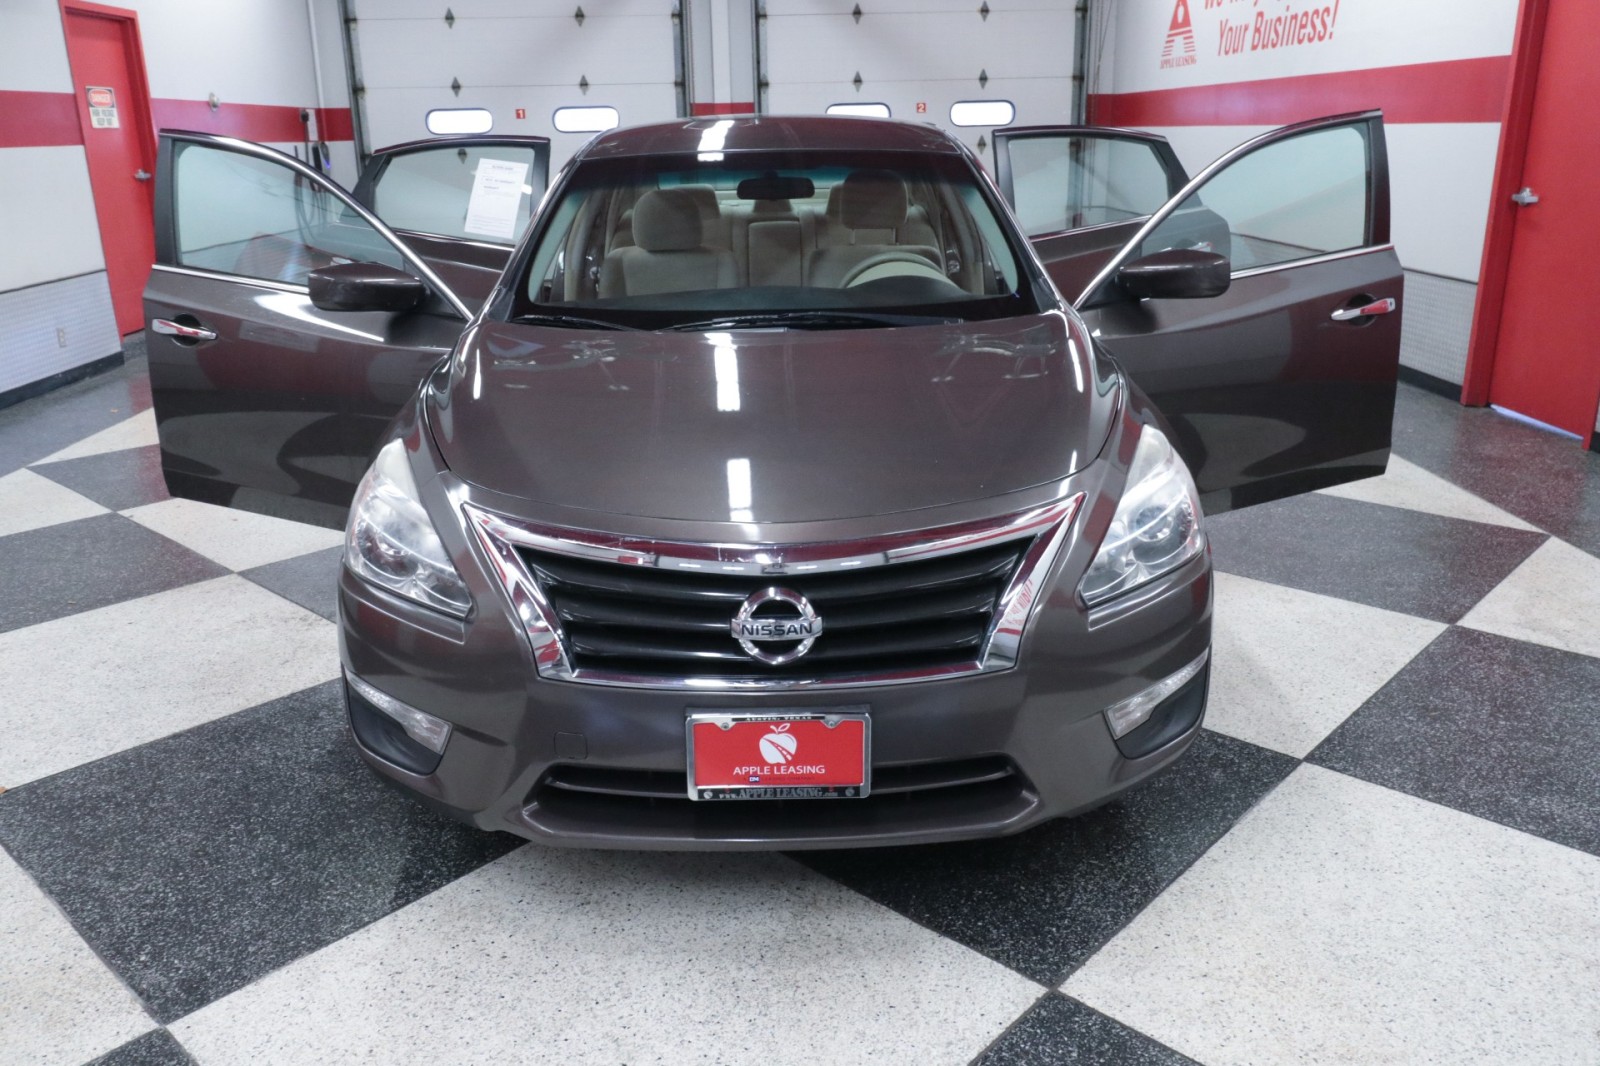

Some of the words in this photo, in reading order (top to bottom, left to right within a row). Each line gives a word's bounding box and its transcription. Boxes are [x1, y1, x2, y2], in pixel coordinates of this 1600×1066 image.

[1218, 18, 1249, 56] Your
[1250, 0, 1339, 51] Business!
[917, 103, 925, 113] 2
[741, 623, 813, 636] NISSAN
[733, 766, 771, 776] APPLE
[773, 765, 826, 775] LEASING
